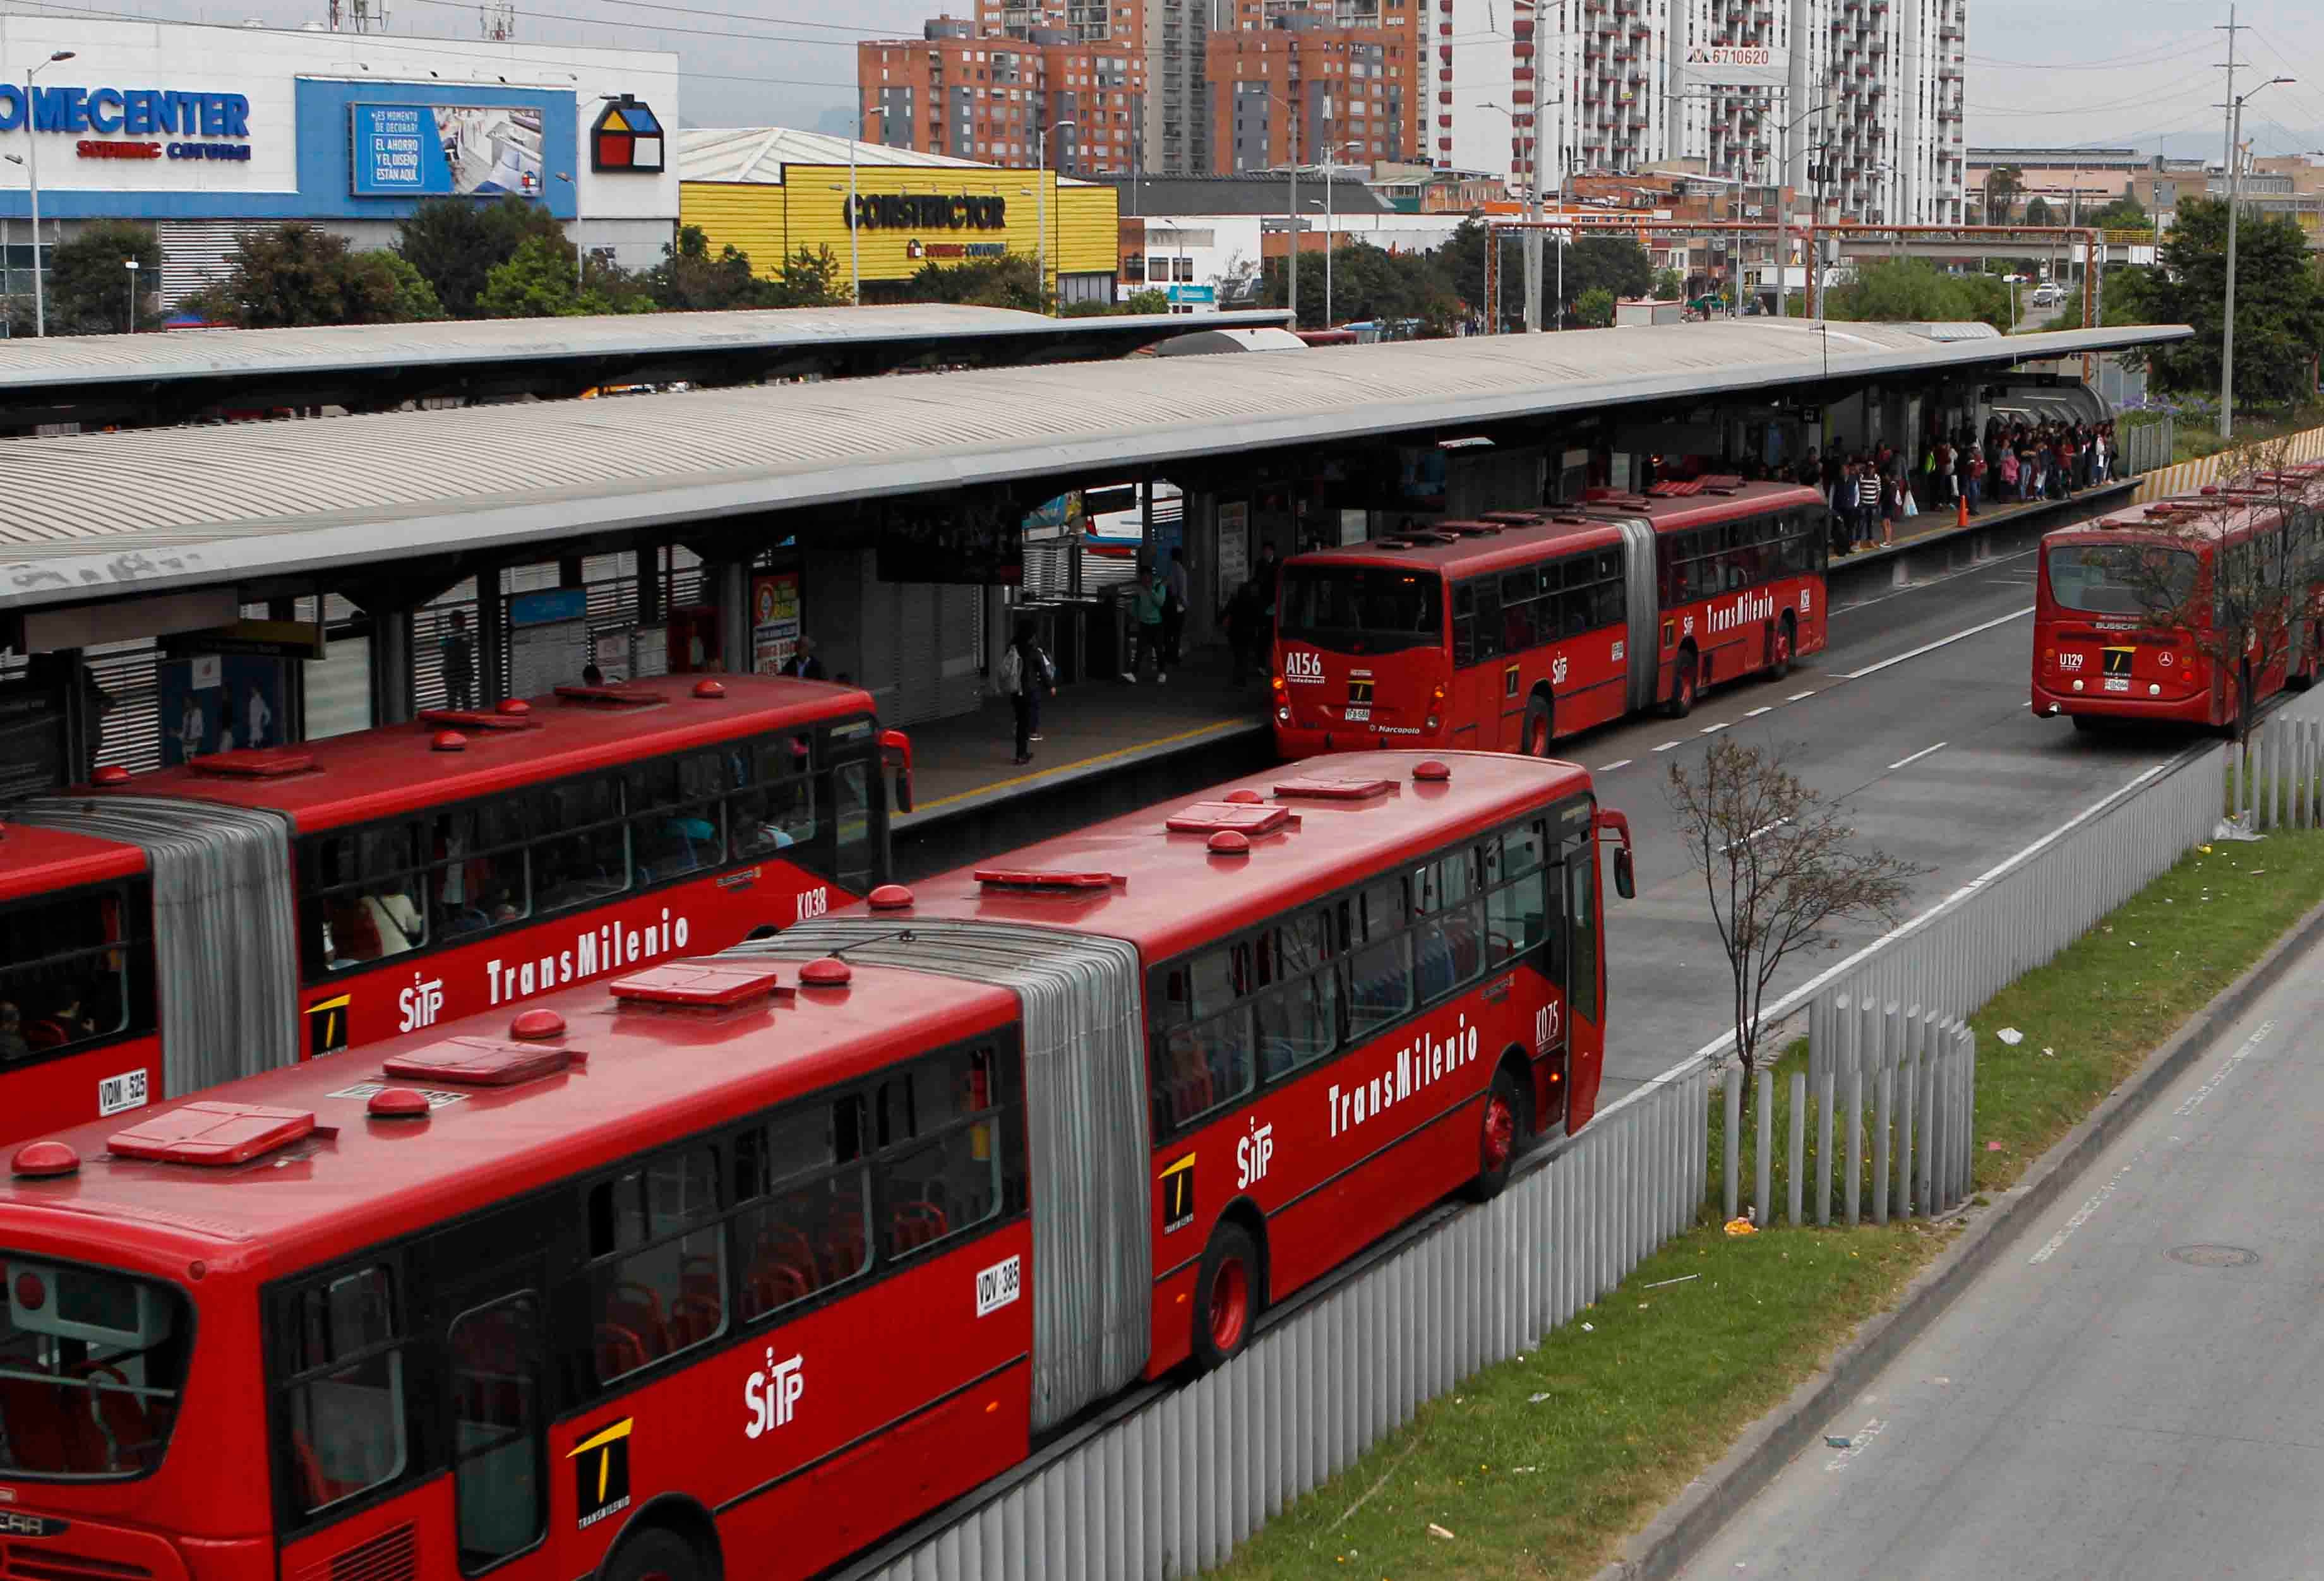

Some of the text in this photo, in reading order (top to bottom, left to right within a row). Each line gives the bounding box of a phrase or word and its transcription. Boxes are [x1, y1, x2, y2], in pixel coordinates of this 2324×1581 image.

[1712, 49, 1769, 64] 6710620
[375, 123, 385, 132] DE
[376, 138, 418, 151] EL AHORRO
[376, 152, 418, 165] Y EL DISEÑO
[843, 193, 1006, 229] CONSTRUCTOR
[1707, 587, 1773, 634] TransMilenio
[2096, 622, 2138, 630] BUSSCA
[1286, 652, 1322, 675] A156
[2059, 653, 2083, 666] U129
[1377, 725, 1420, 735] Marcopolo
[796, 886, 827, 920] K038
[486, 907, 688, 1005] TransMilenio
[1535, 999, 1559, 1045] K075
[1329, 1013, 1477, 1137] TransMilenio
[577, 1494, 631, 1531] TRANSMILENIO
